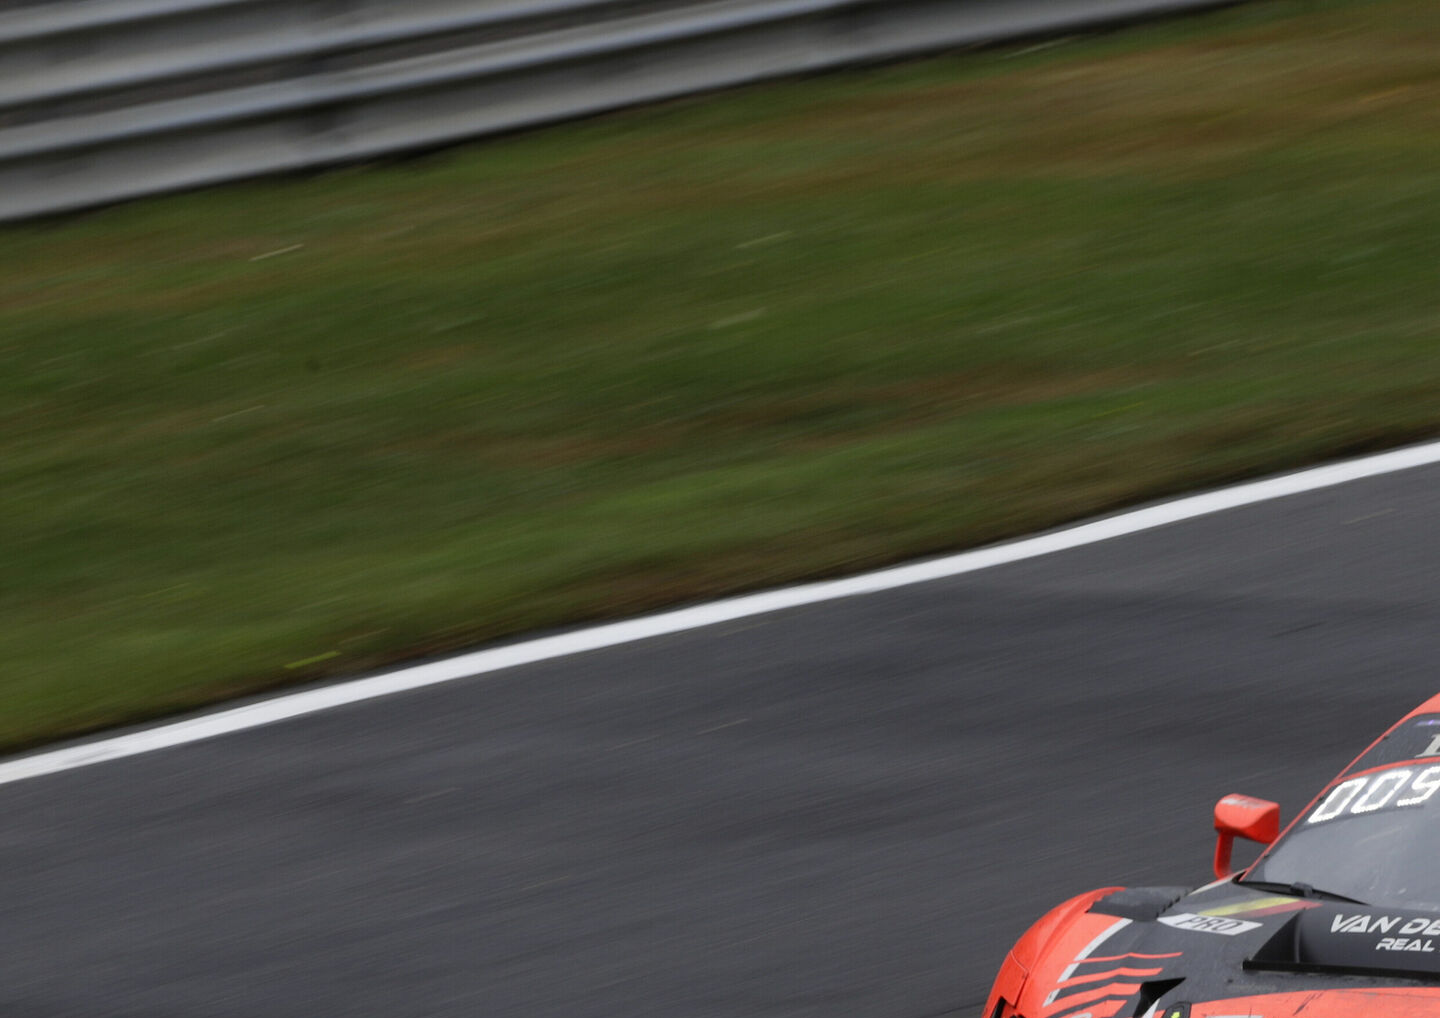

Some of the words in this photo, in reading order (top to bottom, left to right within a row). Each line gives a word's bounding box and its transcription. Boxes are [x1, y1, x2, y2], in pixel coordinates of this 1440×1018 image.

[1175, 916, 1244, 931] PRO
[1330, 914, 1402, 933] VAN
[1375, 937, 1435, 952] REAL
